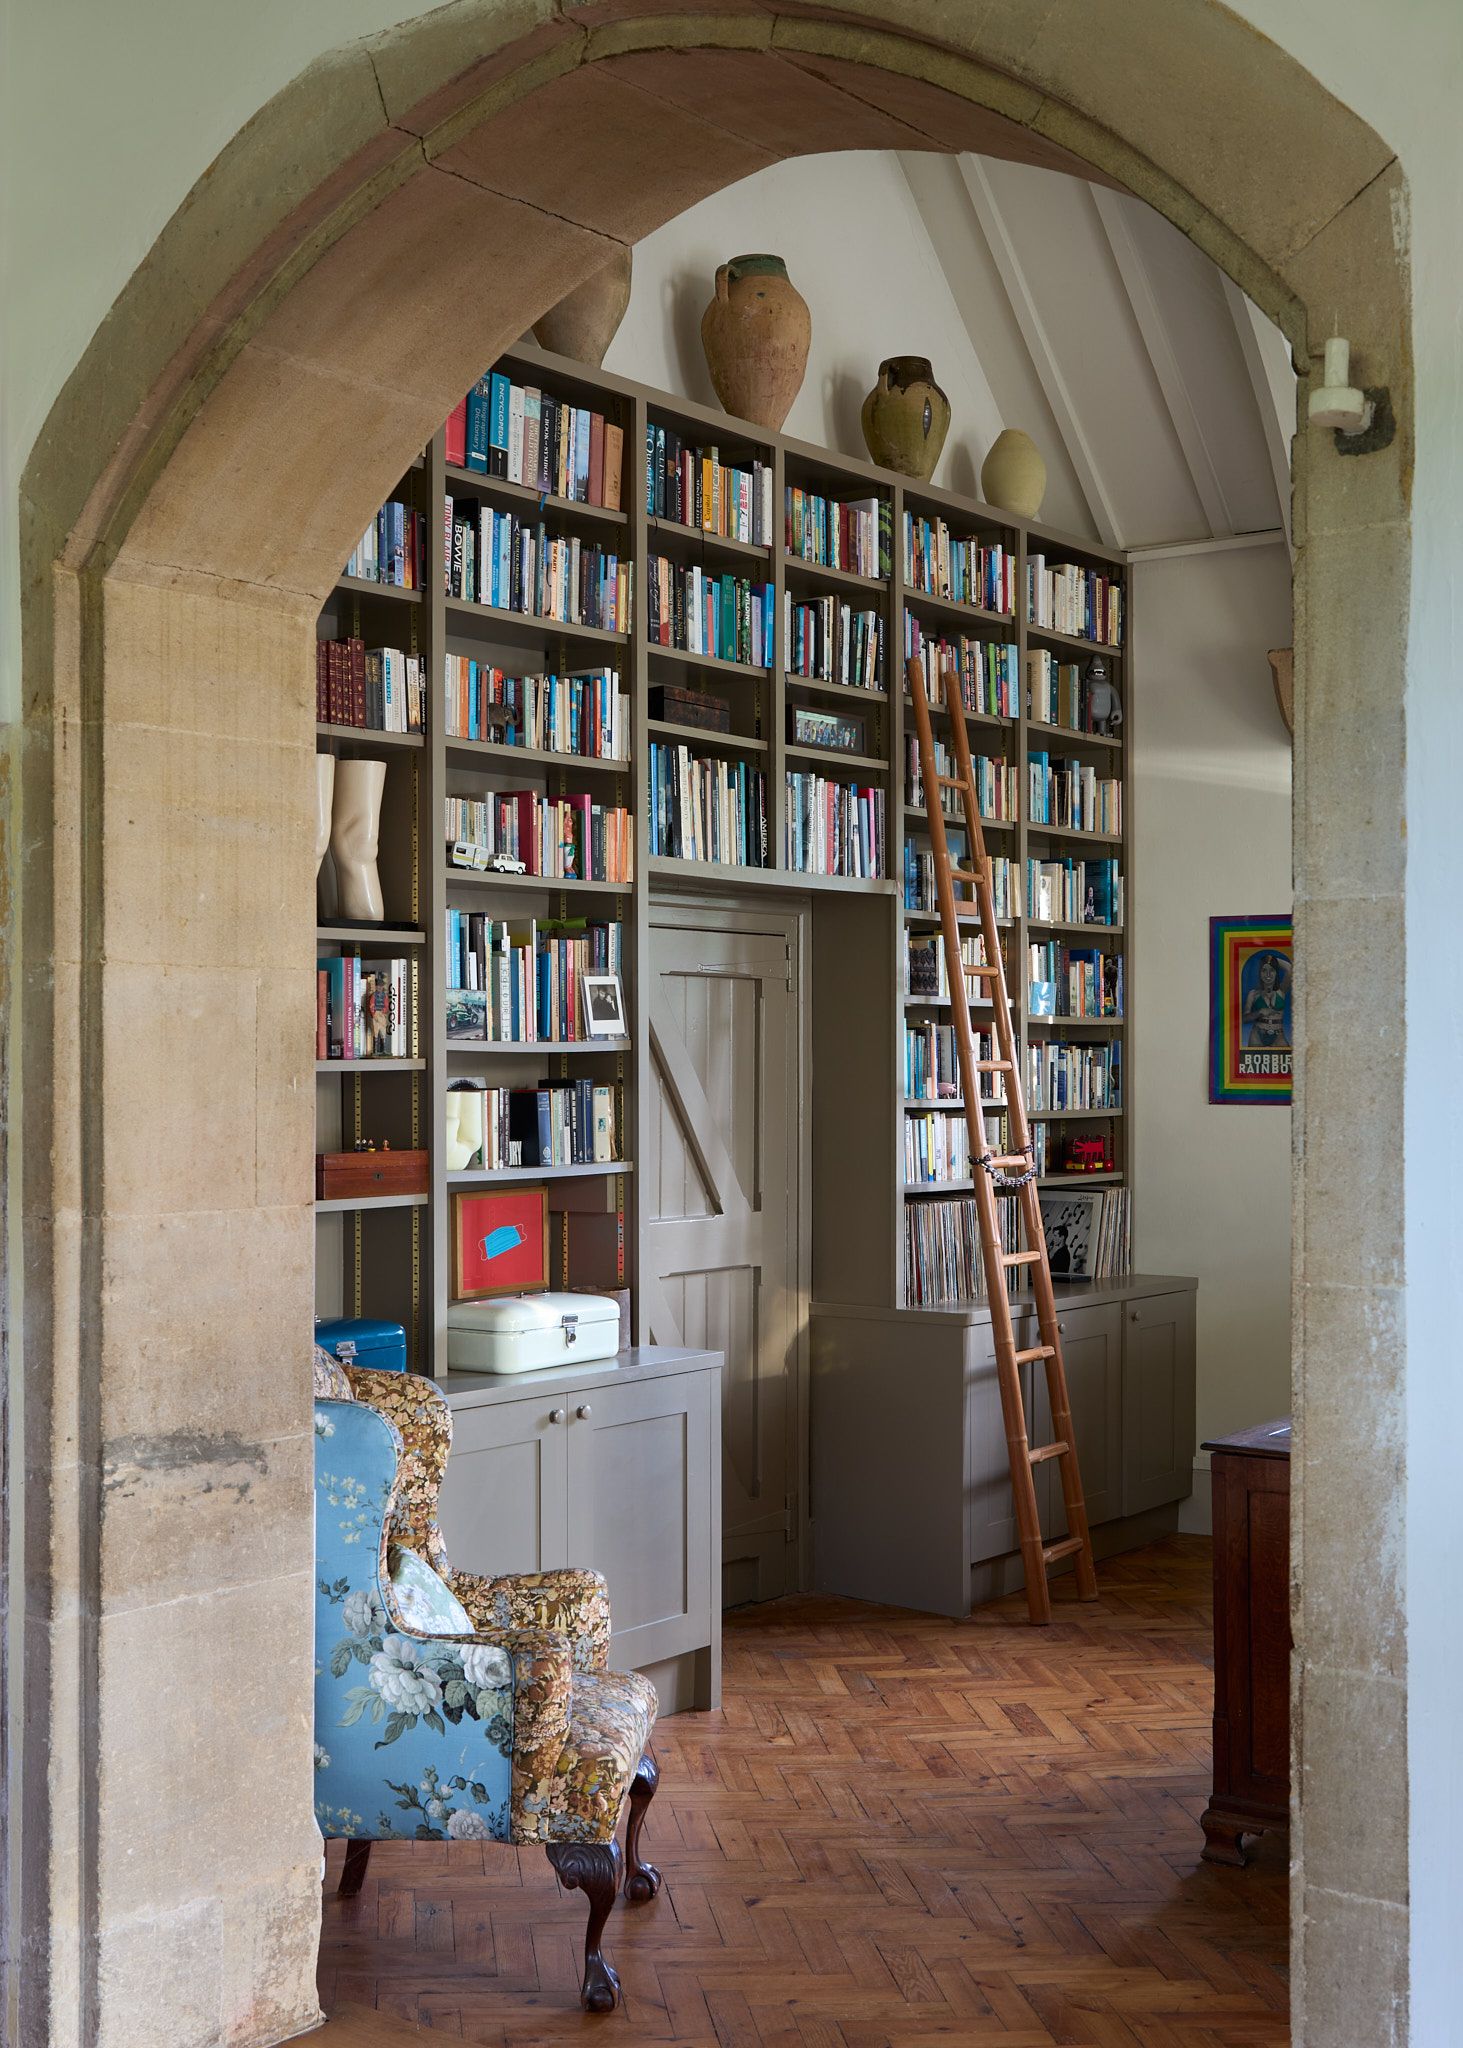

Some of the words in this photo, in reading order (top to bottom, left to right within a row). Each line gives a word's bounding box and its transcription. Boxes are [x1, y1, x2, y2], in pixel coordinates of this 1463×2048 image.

[472, 407, 480, 450] Dictionary
[480, 401, 488, 452] Biographical
[453, 524, 463, 573] BOWIE
[386, 983, 398, 1036] droog
[1244, 1054, 1292, 1065] BOBBIE
